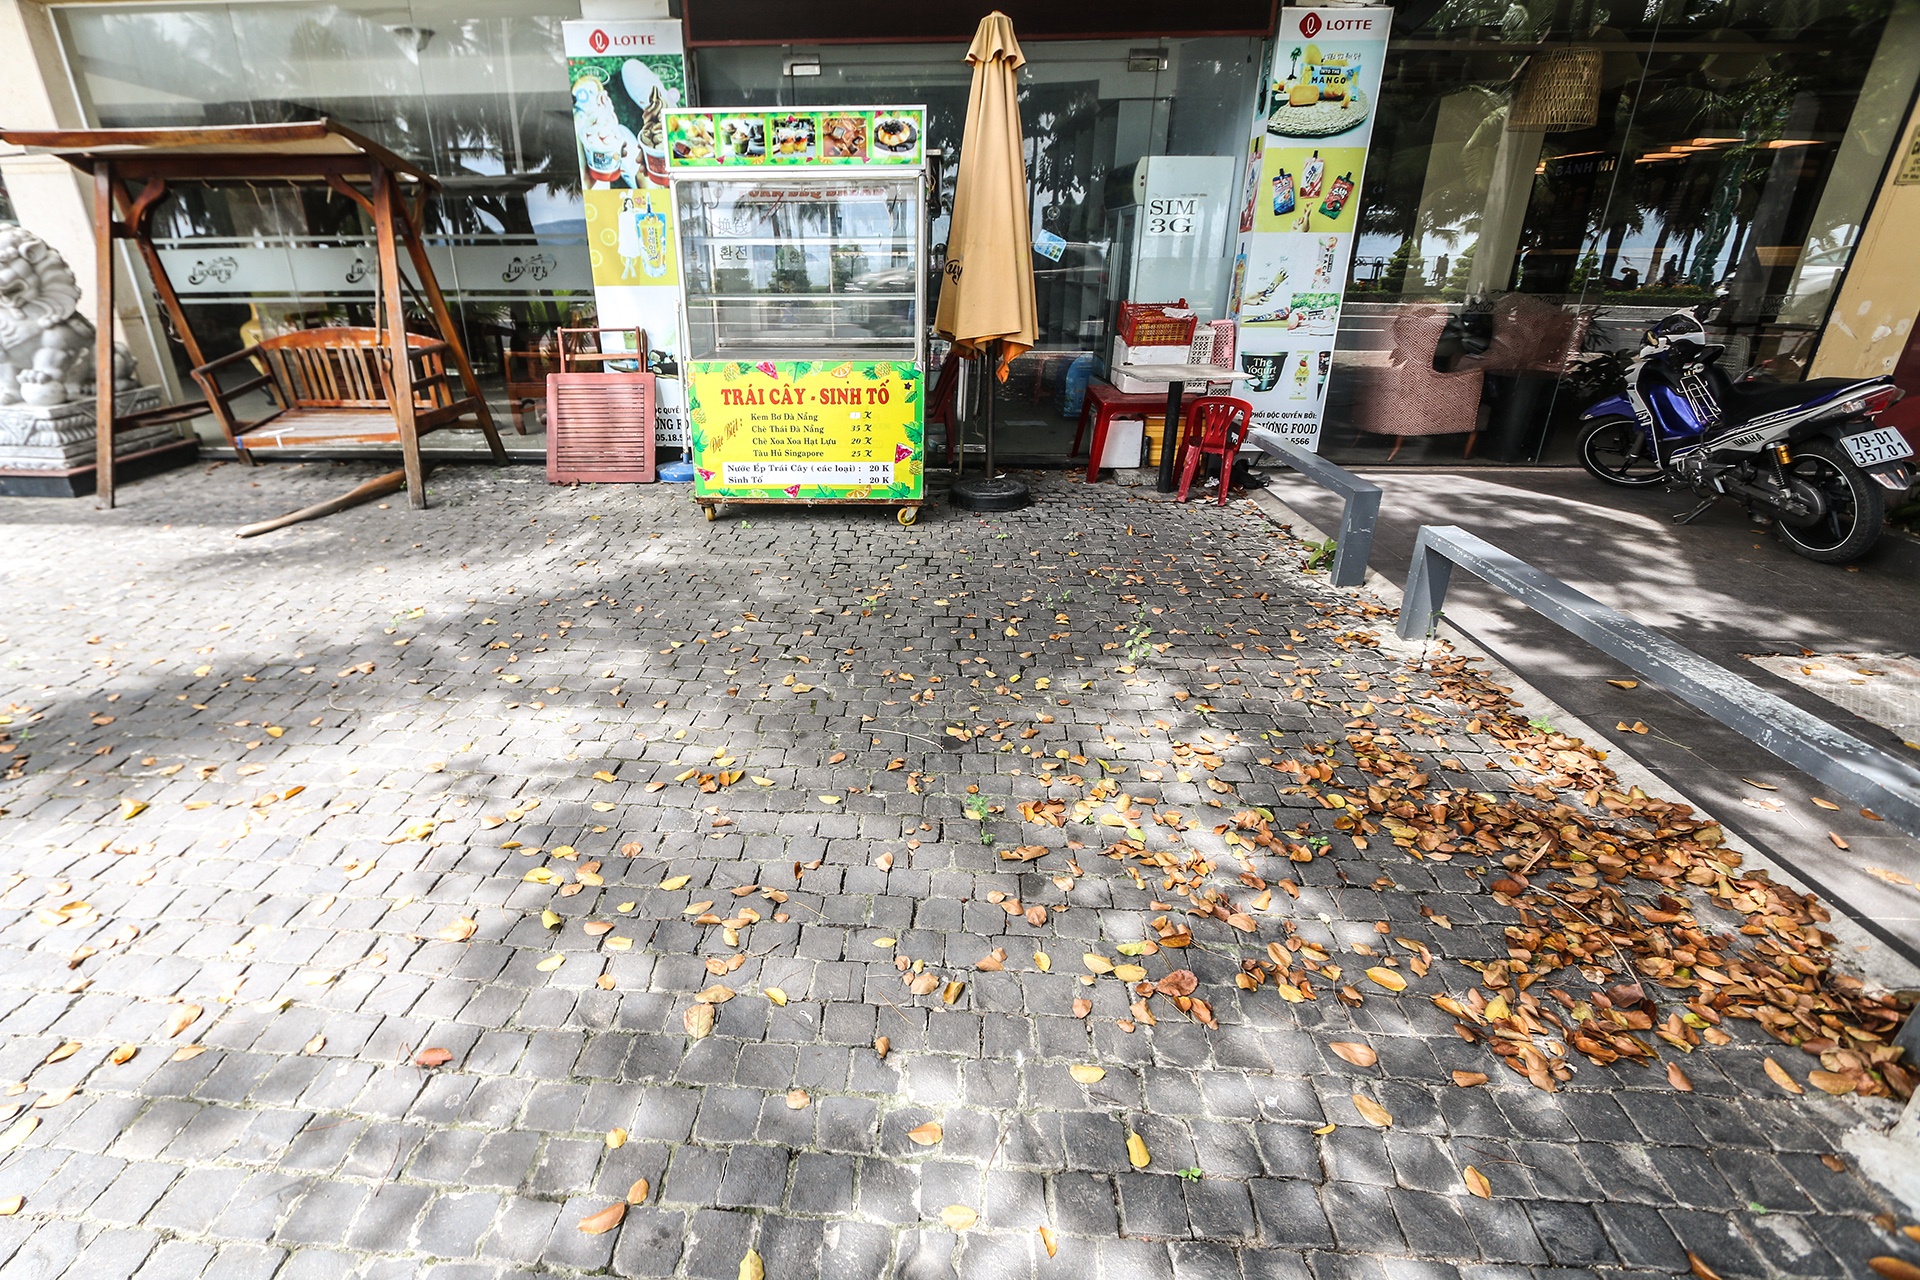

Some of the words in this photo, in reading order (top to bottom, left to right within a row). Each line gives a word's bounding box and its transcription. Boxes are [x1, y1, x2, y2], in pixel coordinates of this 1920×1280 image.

[1326, 20, 1372, 31] LOTTE
[613, 35, 656, 46] LOTTE
[1555, 162, 1593, 176] BÁNH
[1150, 199, 1196, 215] SIM
[1150, 218, 1193, 233] 3G
[719, 245, 748, 261] 환전
[1253, 357, 1273, 367] The
[1247, 365, 1277, 376] Yogurt
[721, 383, 765, 405] TRÁI
[769, 383, 806, 405] CÂY
[820, 388, 862, 405] SINH
[866, 379, 889, 405] TỐ
[750, 413, 768, 421] Kem
[771, 413, 782, 421] Bơ
[784, 413, 794, 421] Đà
[863, 411, 872, 419] K
[752, 425, 767, 433] Chè
[769, 425, 787, 433] Thái
[790, 425, 801, 433] Đà
[863, 424, 872, 432] K
[1291, 423, 1317, 434] FOOD
[752, 437, 767, 445] Chè
[804, 438, 818, 446] Hạt
[820, 438, 836, 447] Lựu
[863, 437, 872, 445] K
[1732, 433, 1765, 447] YAMAHA
[1851, 431, 1893, 450] 79-D1
[753, 449, 768, 457] Tàu
[784, 449, 824, 458] Singapore
[1855, 442, 1908, 463] 357.01
[727, 464, 750, 472] Nước
[753, 463, 766, 473] Ép
[768, 464, 788, 472] Trái
[790, 464, 808, 473] Cây
[728, 476, 749, 484] Sinh
[751, 475, 763, 484] Tố
